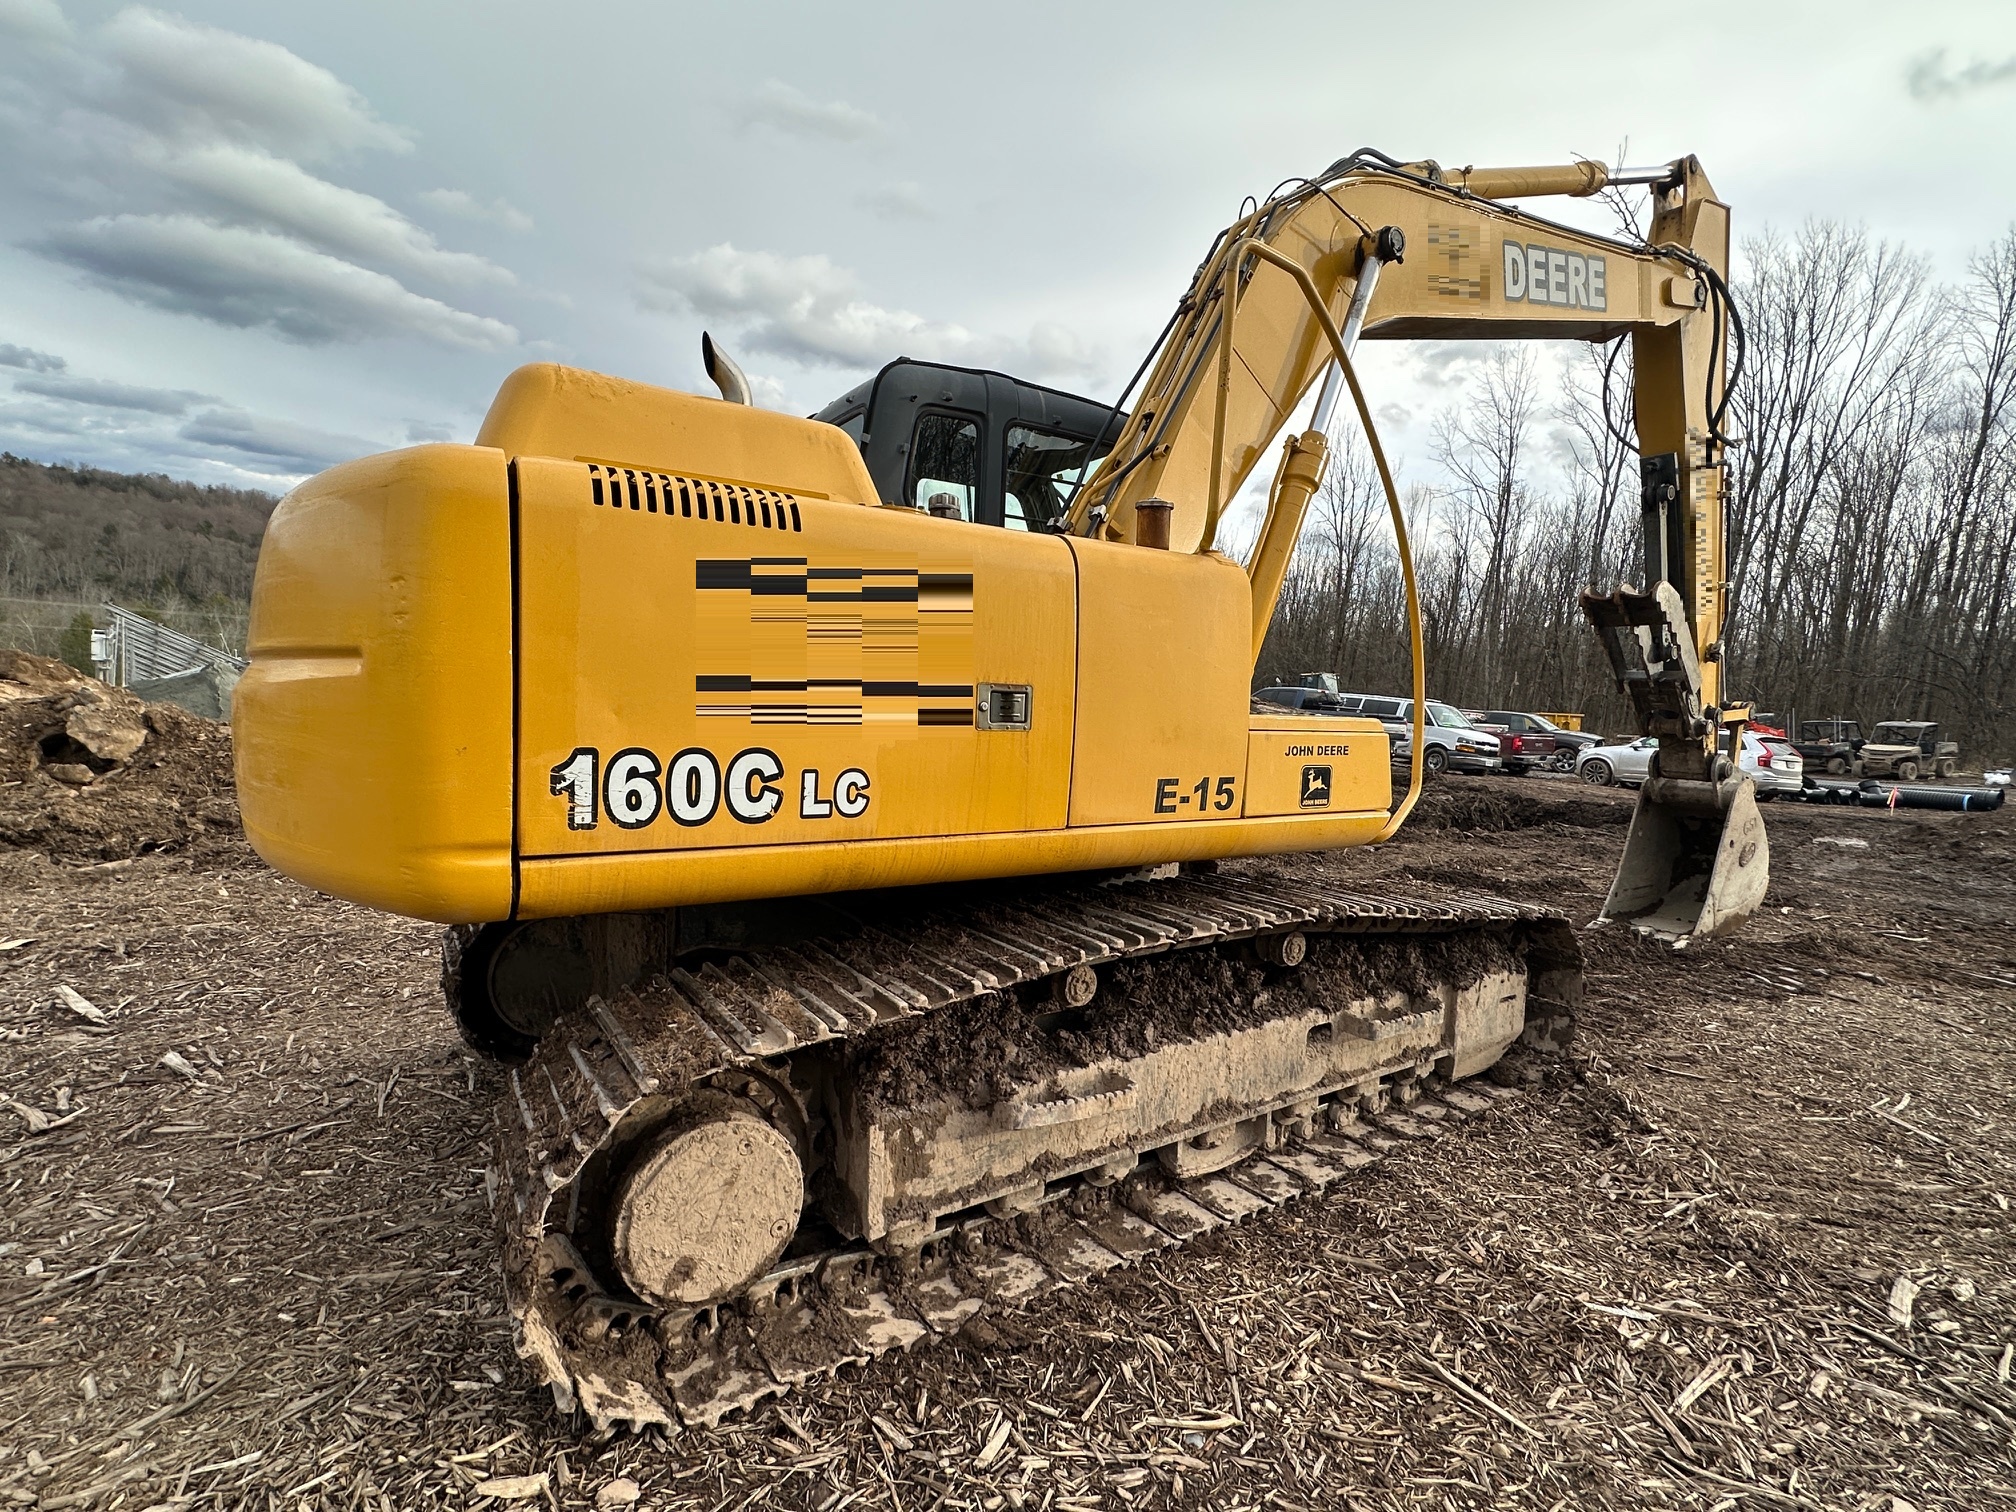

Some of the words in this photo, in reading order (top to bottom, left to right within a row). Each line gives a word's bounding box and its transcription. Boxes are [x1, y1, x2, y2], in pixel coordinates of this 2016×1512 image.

[1503, 240, 1606, 311] DEERE
[1285, 746, 1313, 756] JOHN
[1317, 745, 1349, 755] DEERE
[550, 747, 784, 830] 160C
[800, 768, 870, 819] LC
[1154, 776, 1235, 813] E-15
